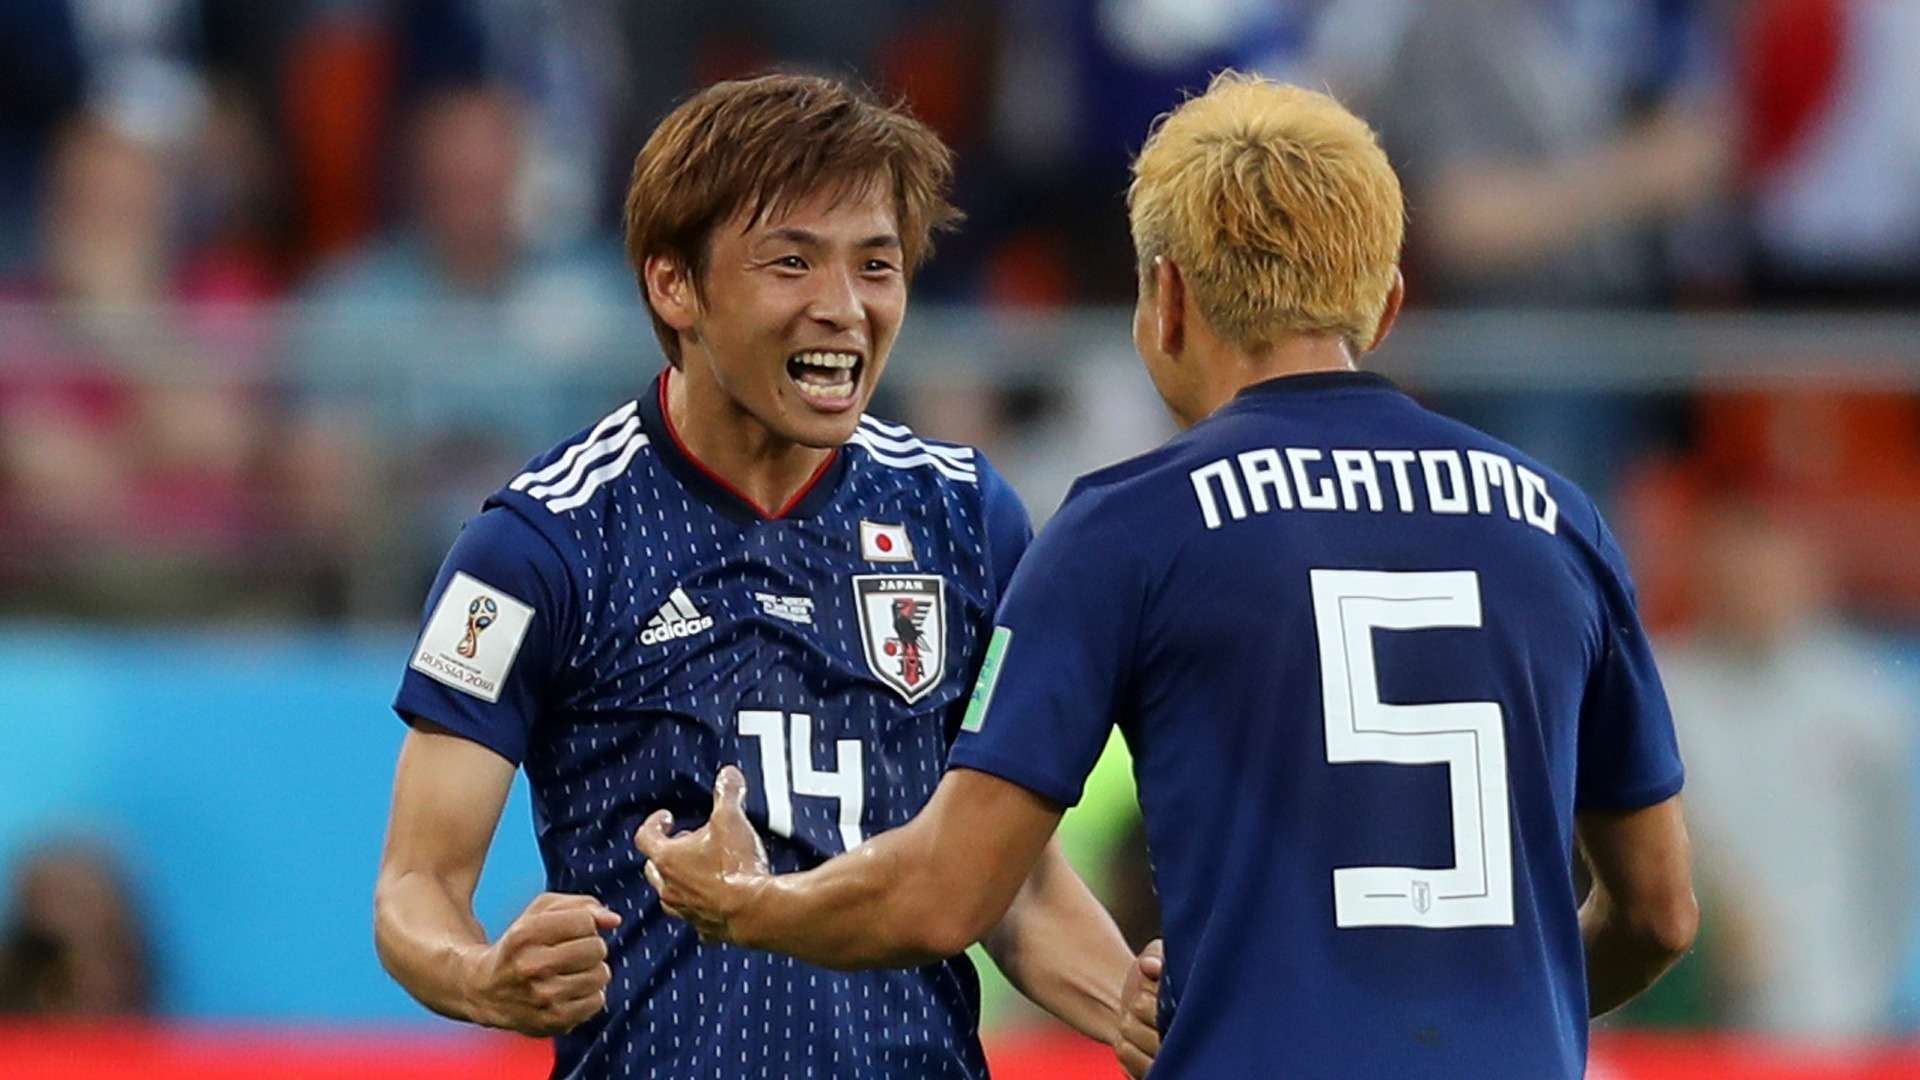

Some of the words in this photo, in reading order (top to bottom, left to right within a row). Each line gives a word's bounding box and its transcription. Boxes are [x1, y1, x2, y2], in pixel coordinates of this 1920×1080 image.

[1191, 448, 1557, 535] NAGATOMO
[878, 580, 923, 591] JAPAN
[640, 615, 714, 645] adidas
[419, 652, 464, 680] RUSSIA
[1310, 569, 1514, 927] 5
[738, 710, 864, 852] 14
